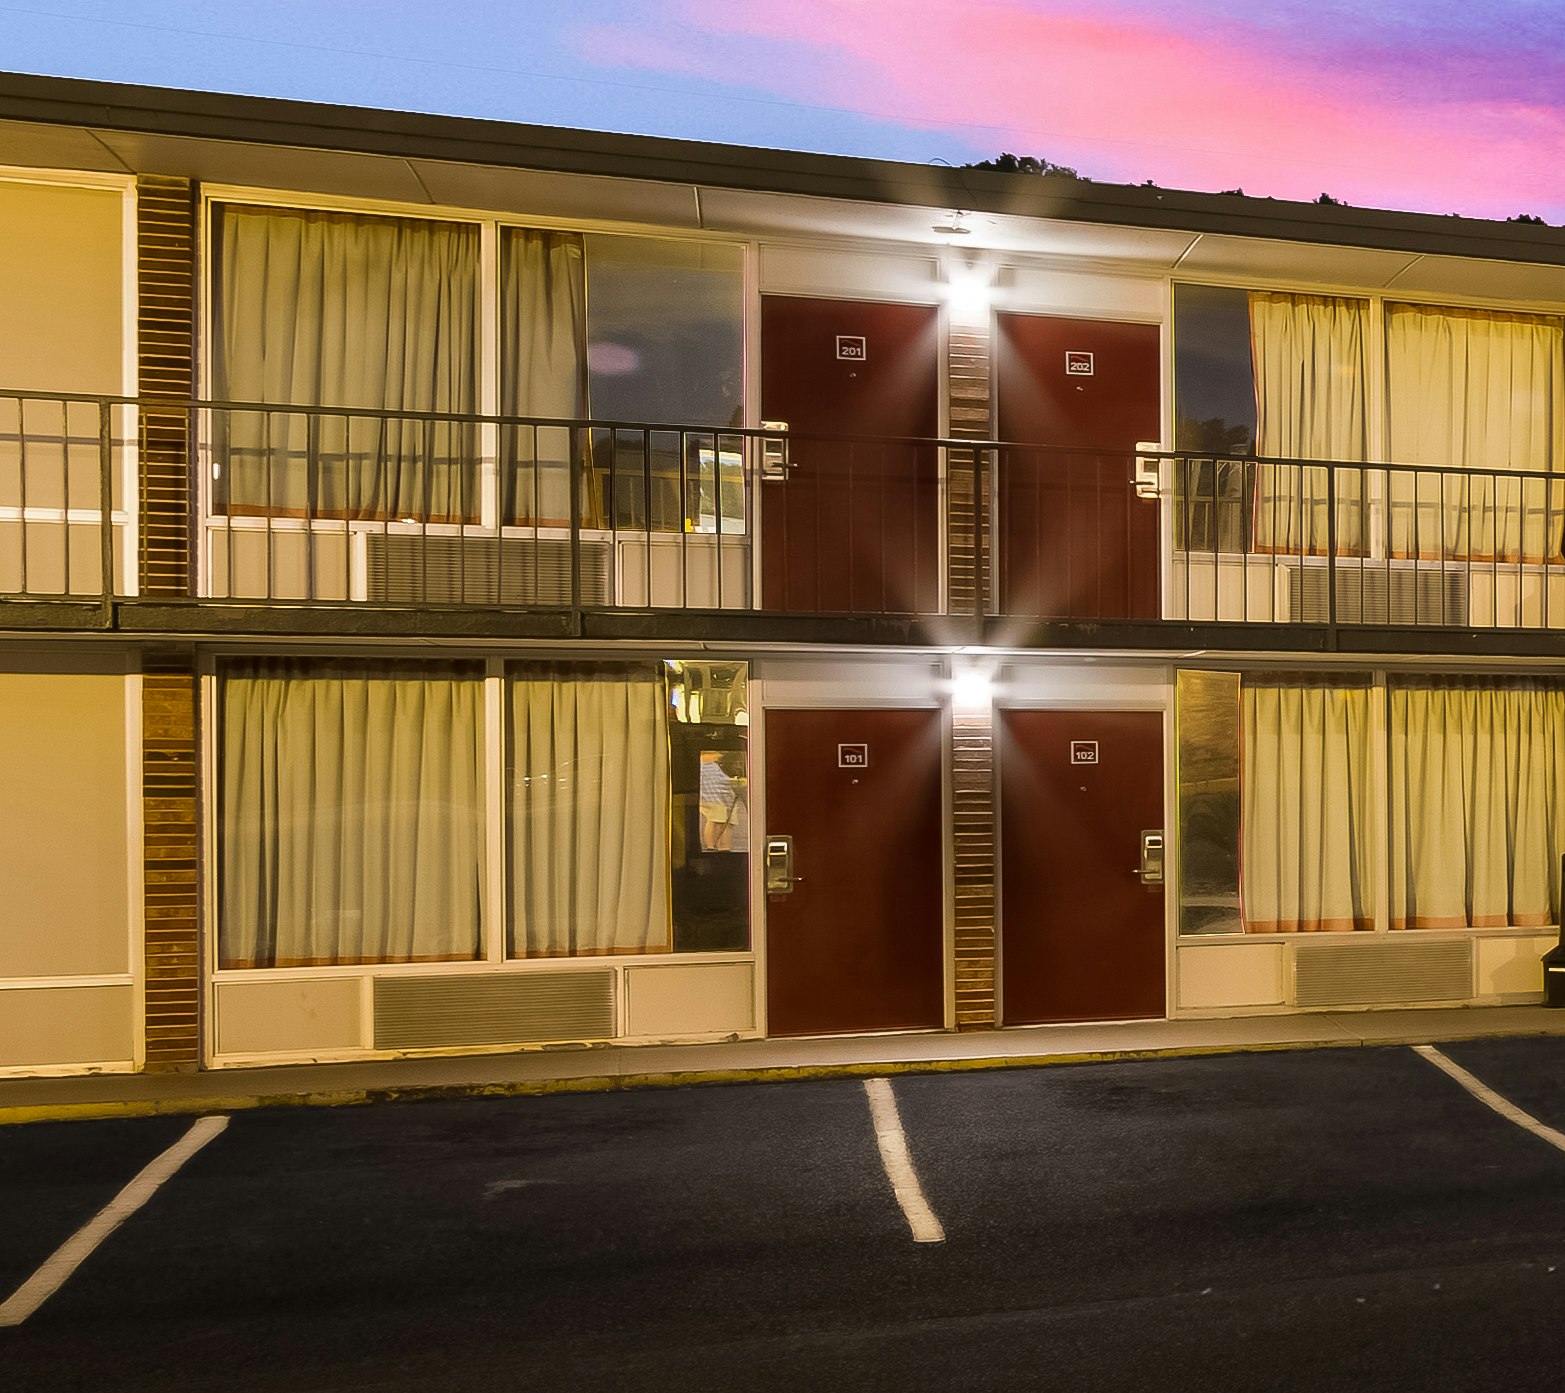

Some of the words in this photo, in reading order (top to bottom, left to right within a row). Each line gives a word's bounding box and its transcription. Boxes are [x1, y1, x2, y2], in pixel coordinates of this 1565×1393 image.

[841, 346, 862, 356] 201
[1070, 361, 1090, 371] 202
[844, 754, 863, 763] 101
[1075, 751, 1095, 760] 102
